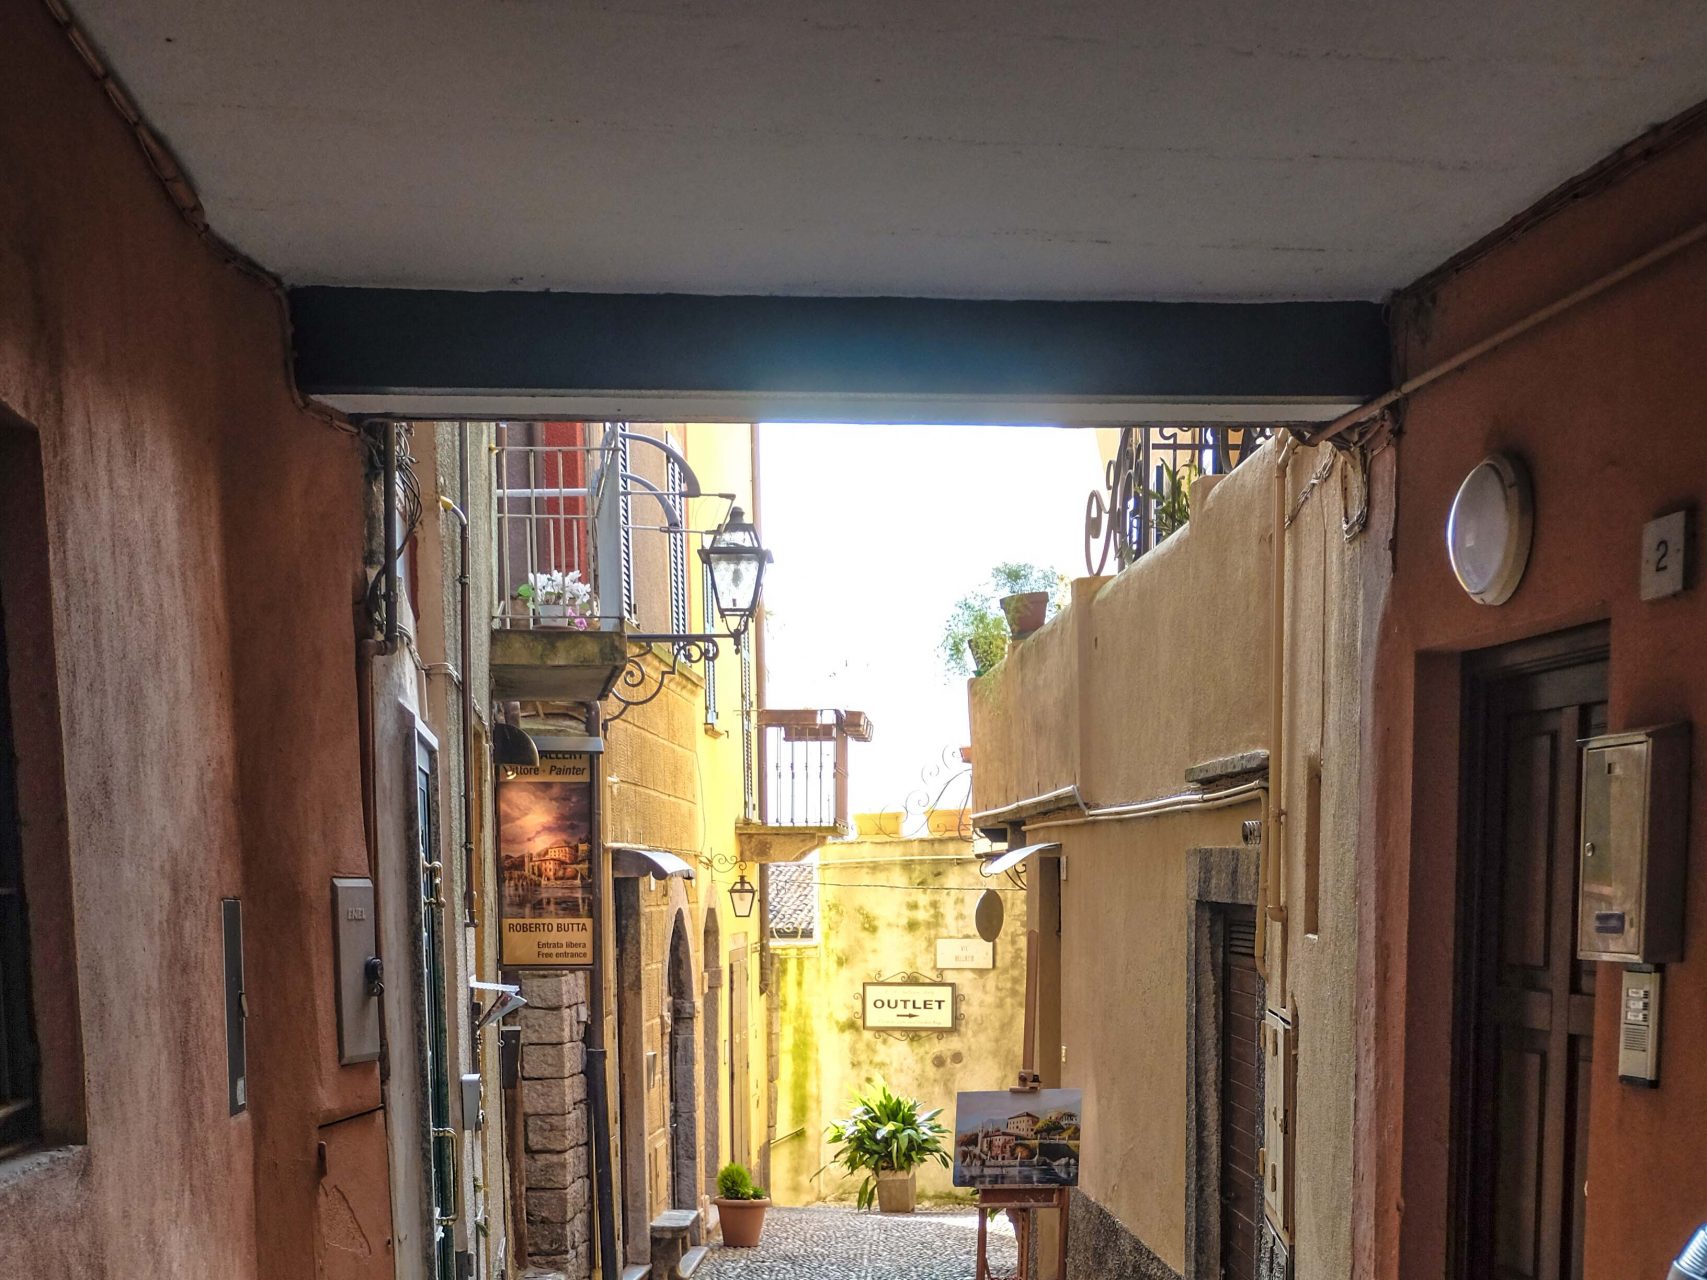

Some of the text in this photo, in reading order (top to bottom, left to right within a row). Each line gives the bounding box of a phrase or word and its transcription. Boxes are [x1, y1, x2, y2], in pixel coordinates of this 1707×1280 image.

[1655, 539, 1669, 572] 2
[549, 765, 586, 776] Painter
[347, 907, 366, 920] ENEL
[508, 922, 588, 932] ROBERTO BUTTA
[537, 941, 587, 949] Entrata libera
[537, 951, 588, 959] Free entrance
[873, 998, 945, 1010] OUTLET
